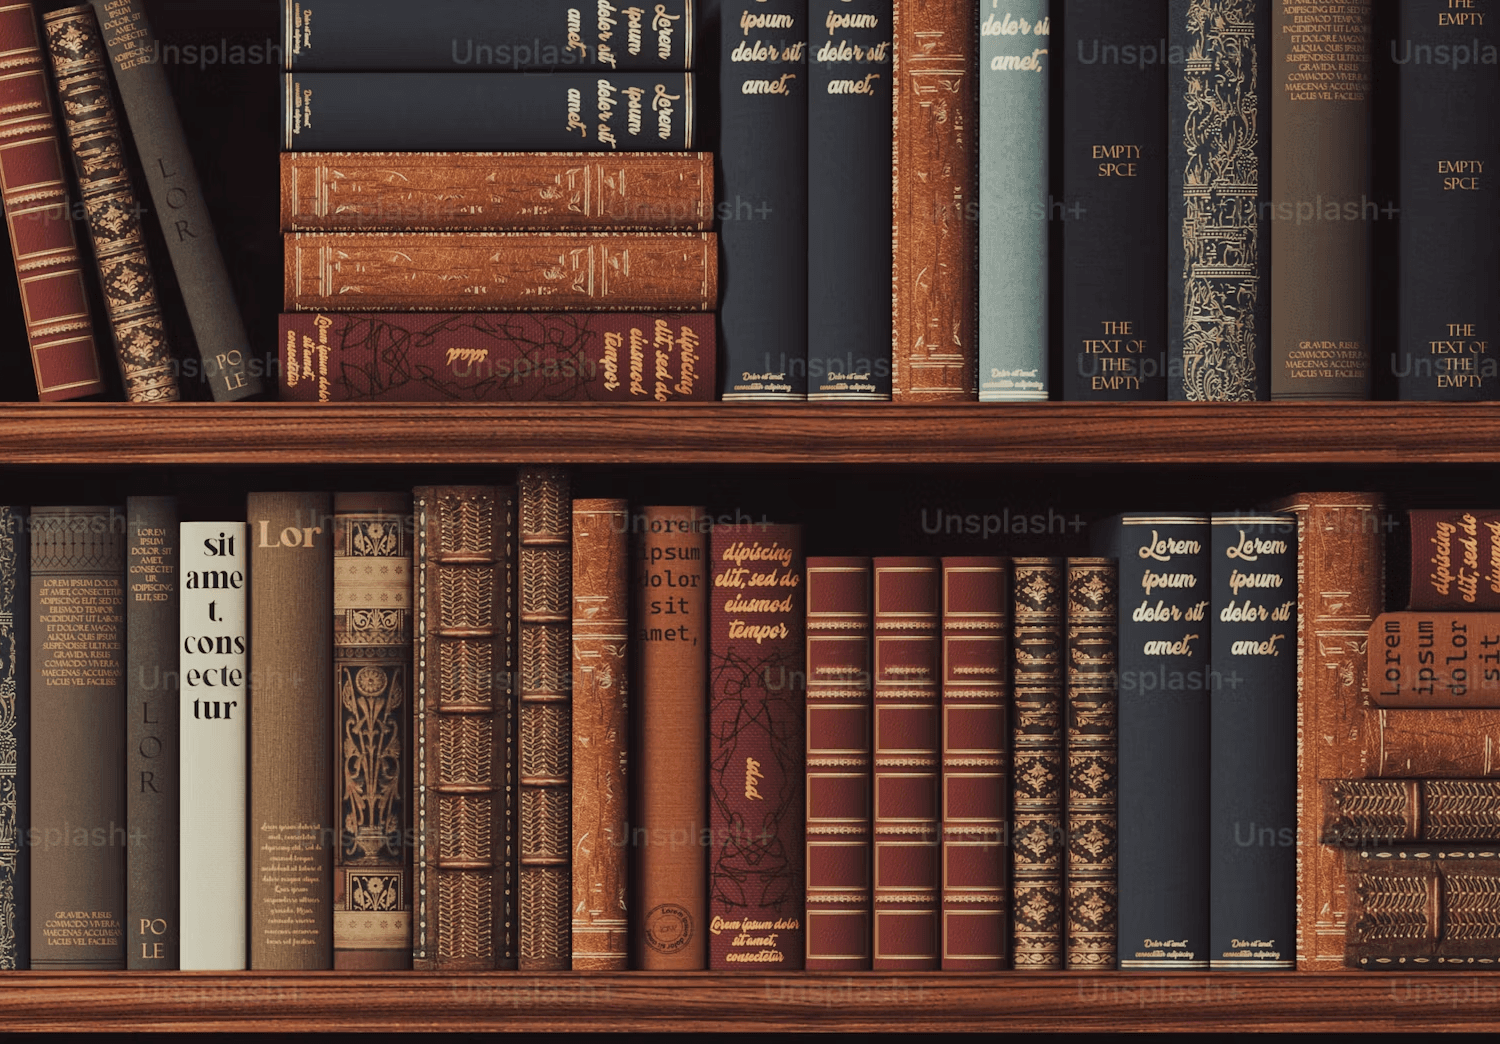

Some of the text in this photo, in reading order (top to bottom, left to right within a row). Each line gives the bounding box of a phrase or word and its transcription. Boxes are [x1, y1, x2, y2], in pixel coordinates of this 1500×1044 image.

[740, 11, 794, 35] ipsum
[731, 40, 805, 62] dolor sit
[742, 74, 795, 95] amet,
[1093, 145, 1139, 158] EMPTY
[1099, 163, 1136, 176] SPCE
[1102, 322, 1132, 334] THE
[1083, 340, 1143, 353] TEXT OF
[446, 348, 488, 366] sdad
[1100, 358, 1130, 371] THE
[1093, 376, 1138, 389] EMPTY
[138, 528, 166, 536] LOREM
[258, 520, 320, 548] Lor
[132, 547, 172, 555] DOLOR SIT
[204, 532, 234, 556] sit
[141, 556, 163, 564] AMET,
[723, 542, 791, 566] dipiscing
[130, 565, 174, 573] CONSECTET
[186, 567, 243, 590] ame
[715, 565, 799, 589] elit, sed do
[40, 588, 71, 596] SIT AMET,
[136, 593, 168, 601] ELIT, SED
[209, 601, 222, 621] t.
[724, 594, 792, 613] eiusmod
[729, 619, 788, 644] tempor
[183, 634, 246, 657] cons
[1380, 621, 1401, 698] Lorem
[1412, 622, 1436, 698] ipsum
[1446, 621, 1467, 697] dolor
[187, 666, 242, 686] ecte
[194, 699, 237, 719] tur
[745, 757, 764, 800] sdad
[140, 919, 166, 935] PO
[710, 915, 799, 935] Lorem ipsum dolor
[732, 933, 778, 947] sit amet,
[142, 943, 164, 958] LE
[726, 949, 784, 962] consectetur
